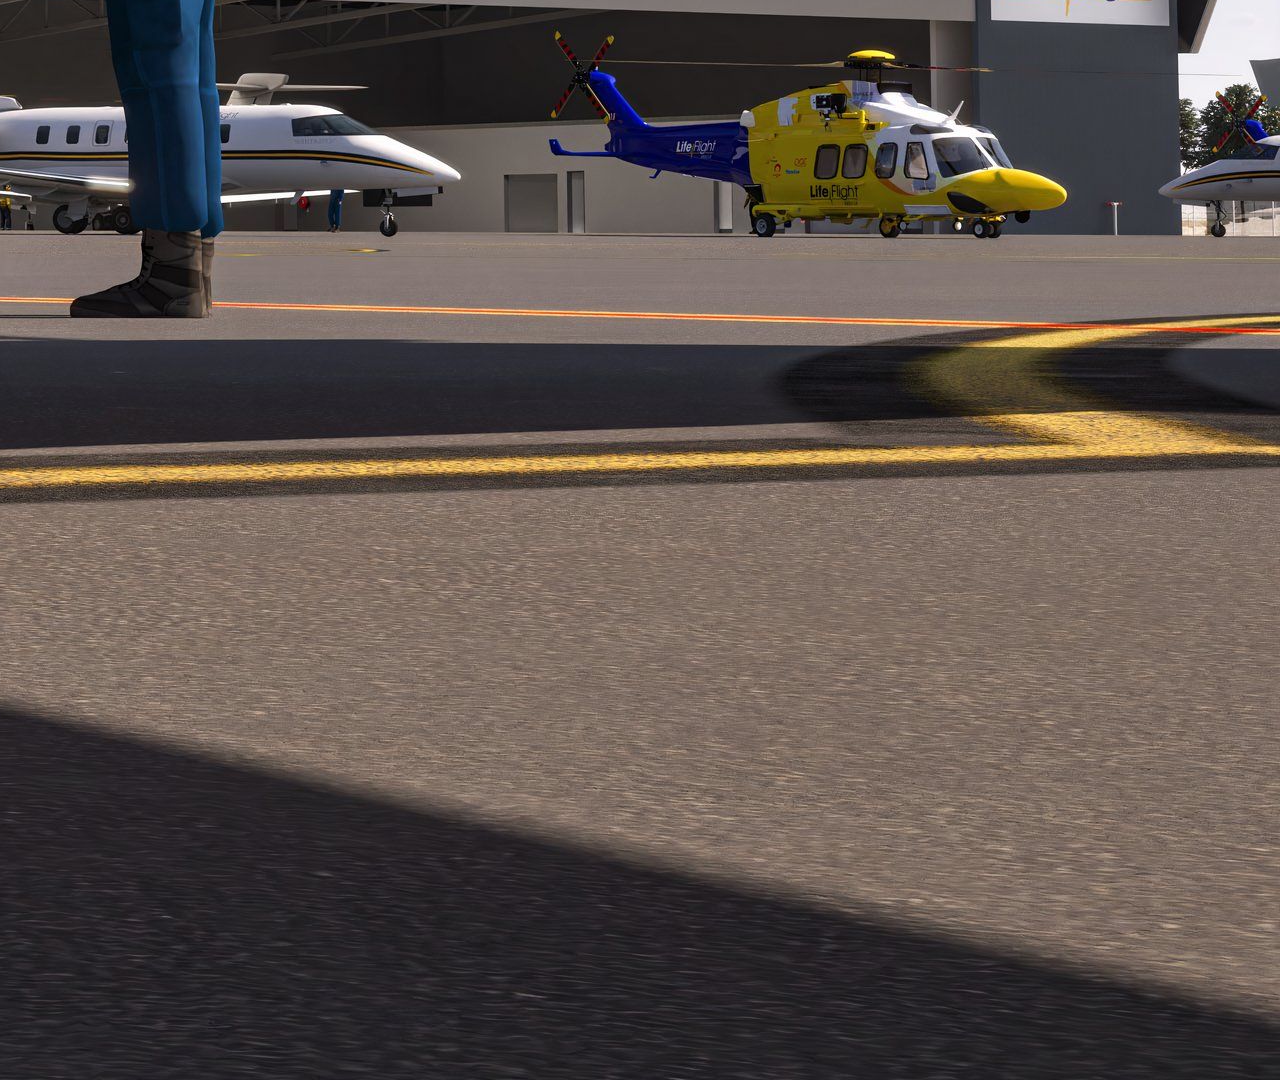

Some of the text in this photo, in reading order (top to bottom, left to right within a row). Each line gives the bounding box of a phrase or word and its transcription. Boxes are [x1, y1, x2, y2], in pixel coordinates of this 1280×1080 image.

[676, 141, 692, 153] Life
[810, 184, 858, 200] Life Flight
